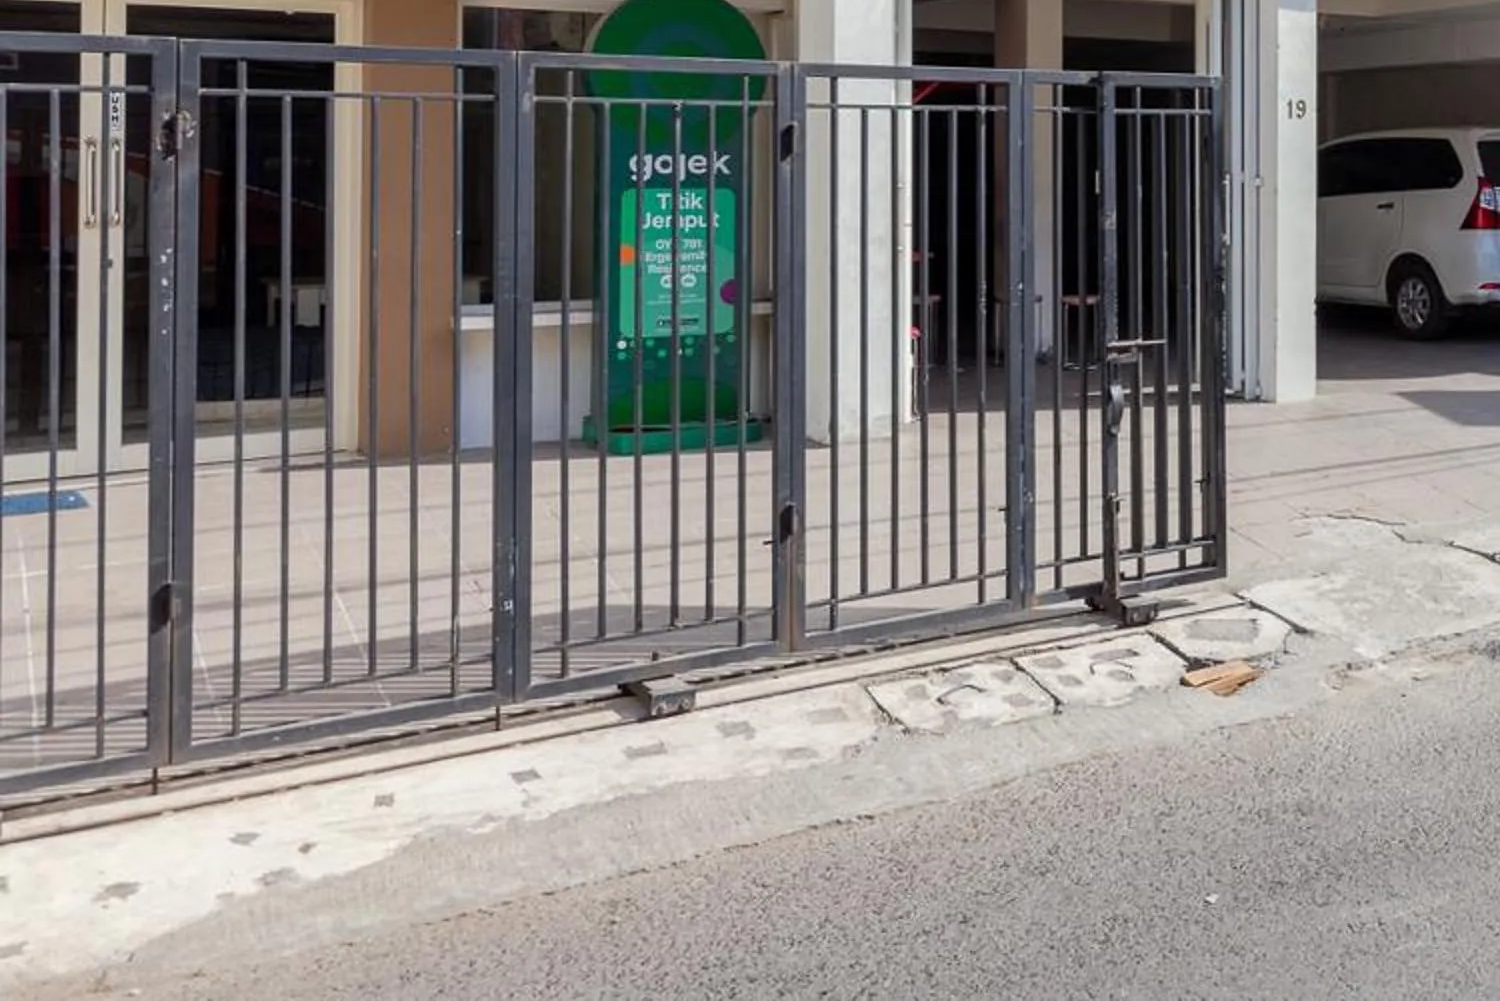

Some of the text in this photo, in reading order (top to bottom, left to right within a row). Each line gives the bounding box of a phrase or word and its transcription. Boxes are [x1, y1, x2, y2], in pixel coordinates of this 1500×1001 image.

[111, 89, 120, 123] USH
[1286, 98, 1307, 120] 19
[629, 151, 732, 181] gojek
[656, 192, 703, 210] Ttik
